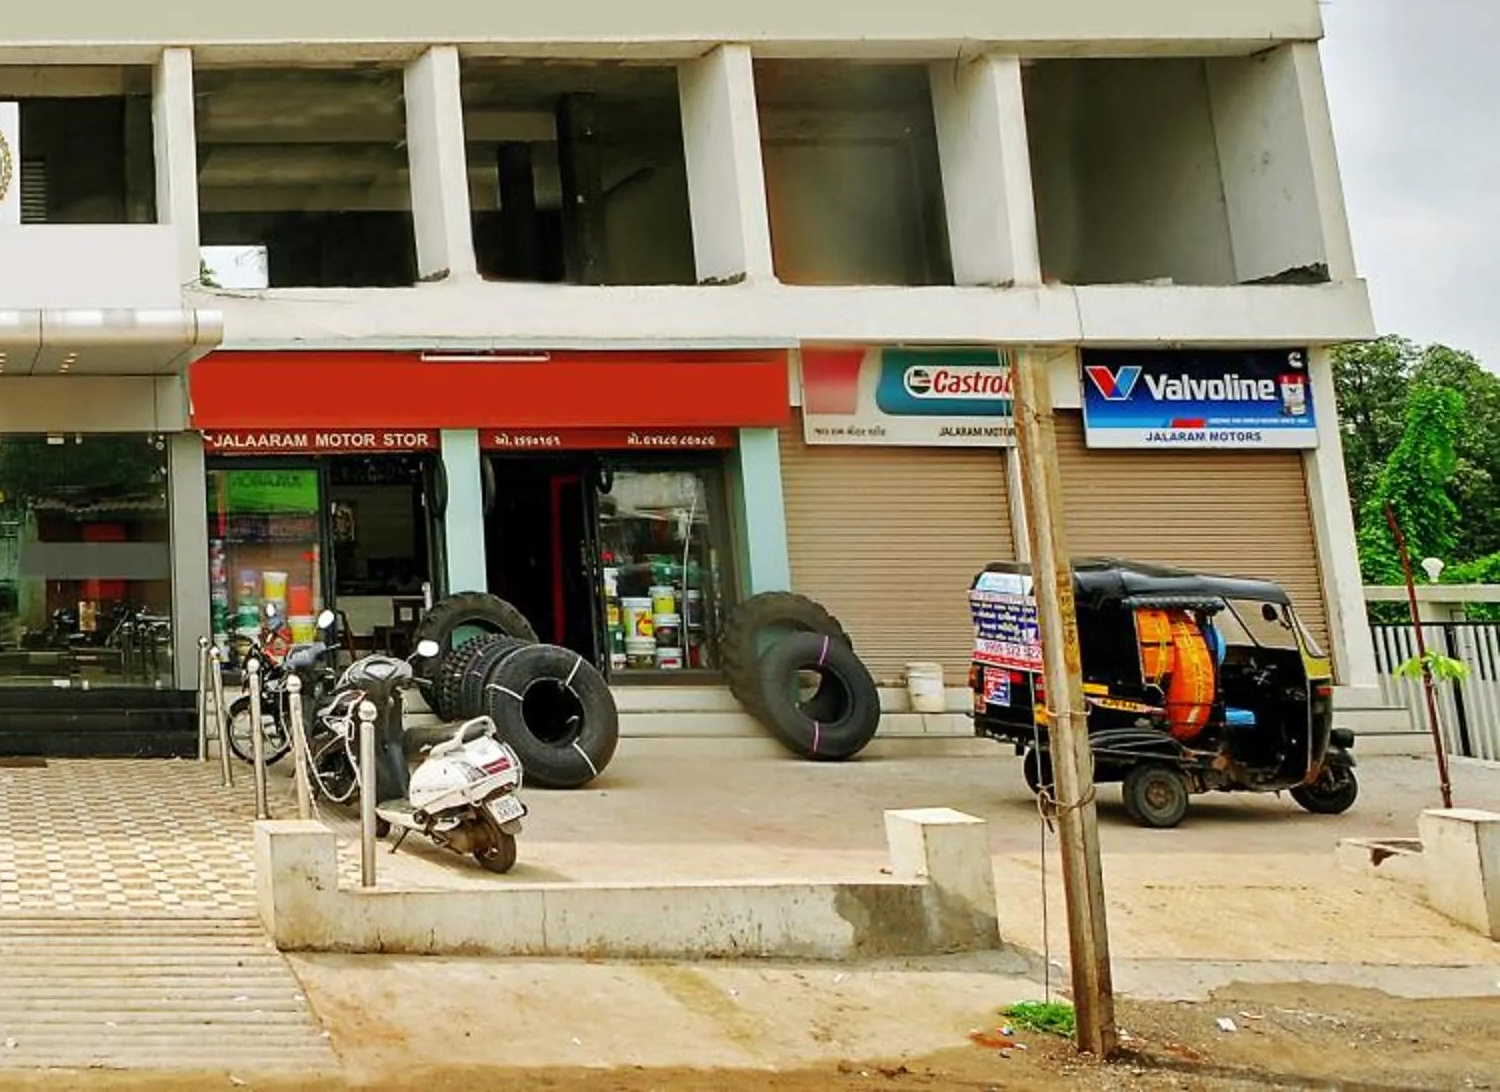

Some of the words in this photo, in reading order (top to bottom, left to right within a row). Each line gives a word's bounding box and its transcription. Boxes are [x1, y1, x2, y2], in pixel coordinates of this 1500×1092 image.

[934, 370, 1013, 394] Castrol
[1144, 374, 1276, 401] Valvoline
[939, 427, 983, 437] JALARAM
[983, 427, 1017, 437] MOTOR
[1145, 432, 1206, 443] JALARAM
[1209, 431, 1262, 442] MOTORS
[213, 434, 308, 448] JALAARAM
[315, 433, 377, 447] MOTOR
[383, 433, 429, 446] STOR
